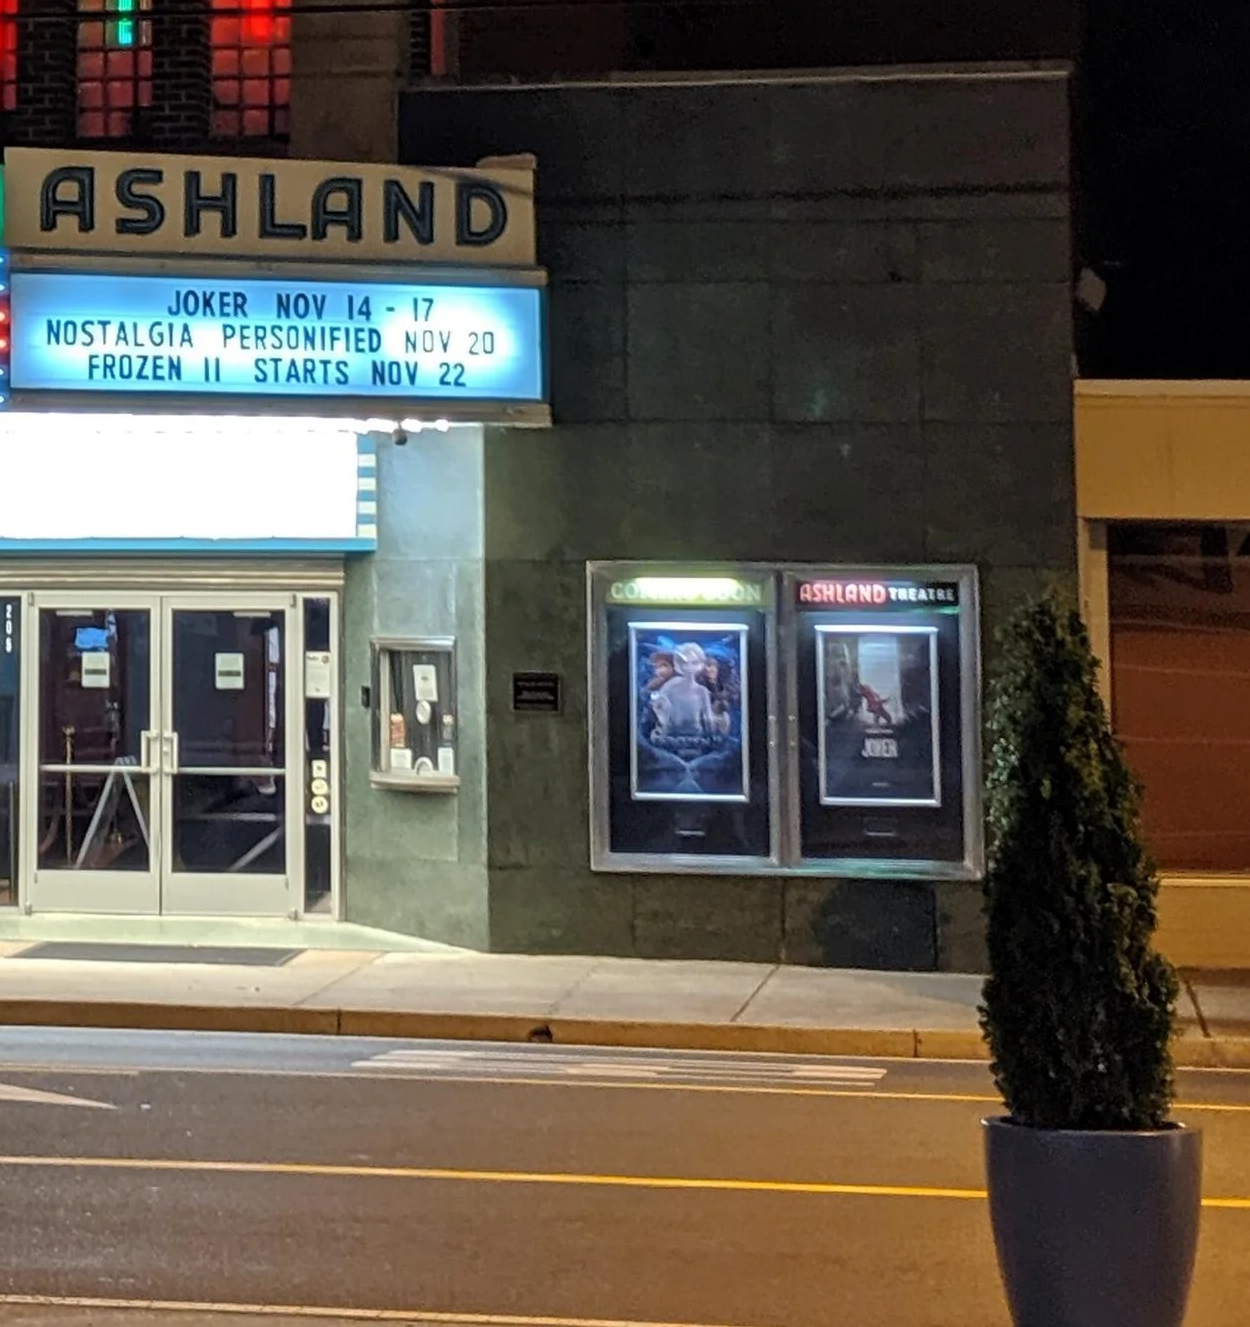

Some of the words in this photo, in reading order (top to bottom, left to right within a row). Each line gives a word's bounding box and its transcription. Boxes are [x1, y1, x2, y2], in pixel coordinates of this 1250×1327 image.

[39, 165, 508, 248] ASHLAND
[167, 290, 249, 318] JOKER
[275, 293, 326, 320] NOV
[348, 295, 373, 321] 14
[412, 298, 435, 323] 17
[46, 320, 194, 348] NOSTALGIA
[222, 325, 383, 353] PERSONIFIED
[405, 329, 452, 354] NOV
[468, 331, 495, 355] 20
[88, 354, 182, 382] FROZEN
[254, 360, 349, 385] STARTS
[371, 361, 418, 387] NOV
[439, 363, 466, 388] 22
[800, 582, 887, 604] ASHLAND
[888, 586, 955, 603] THEATRE
